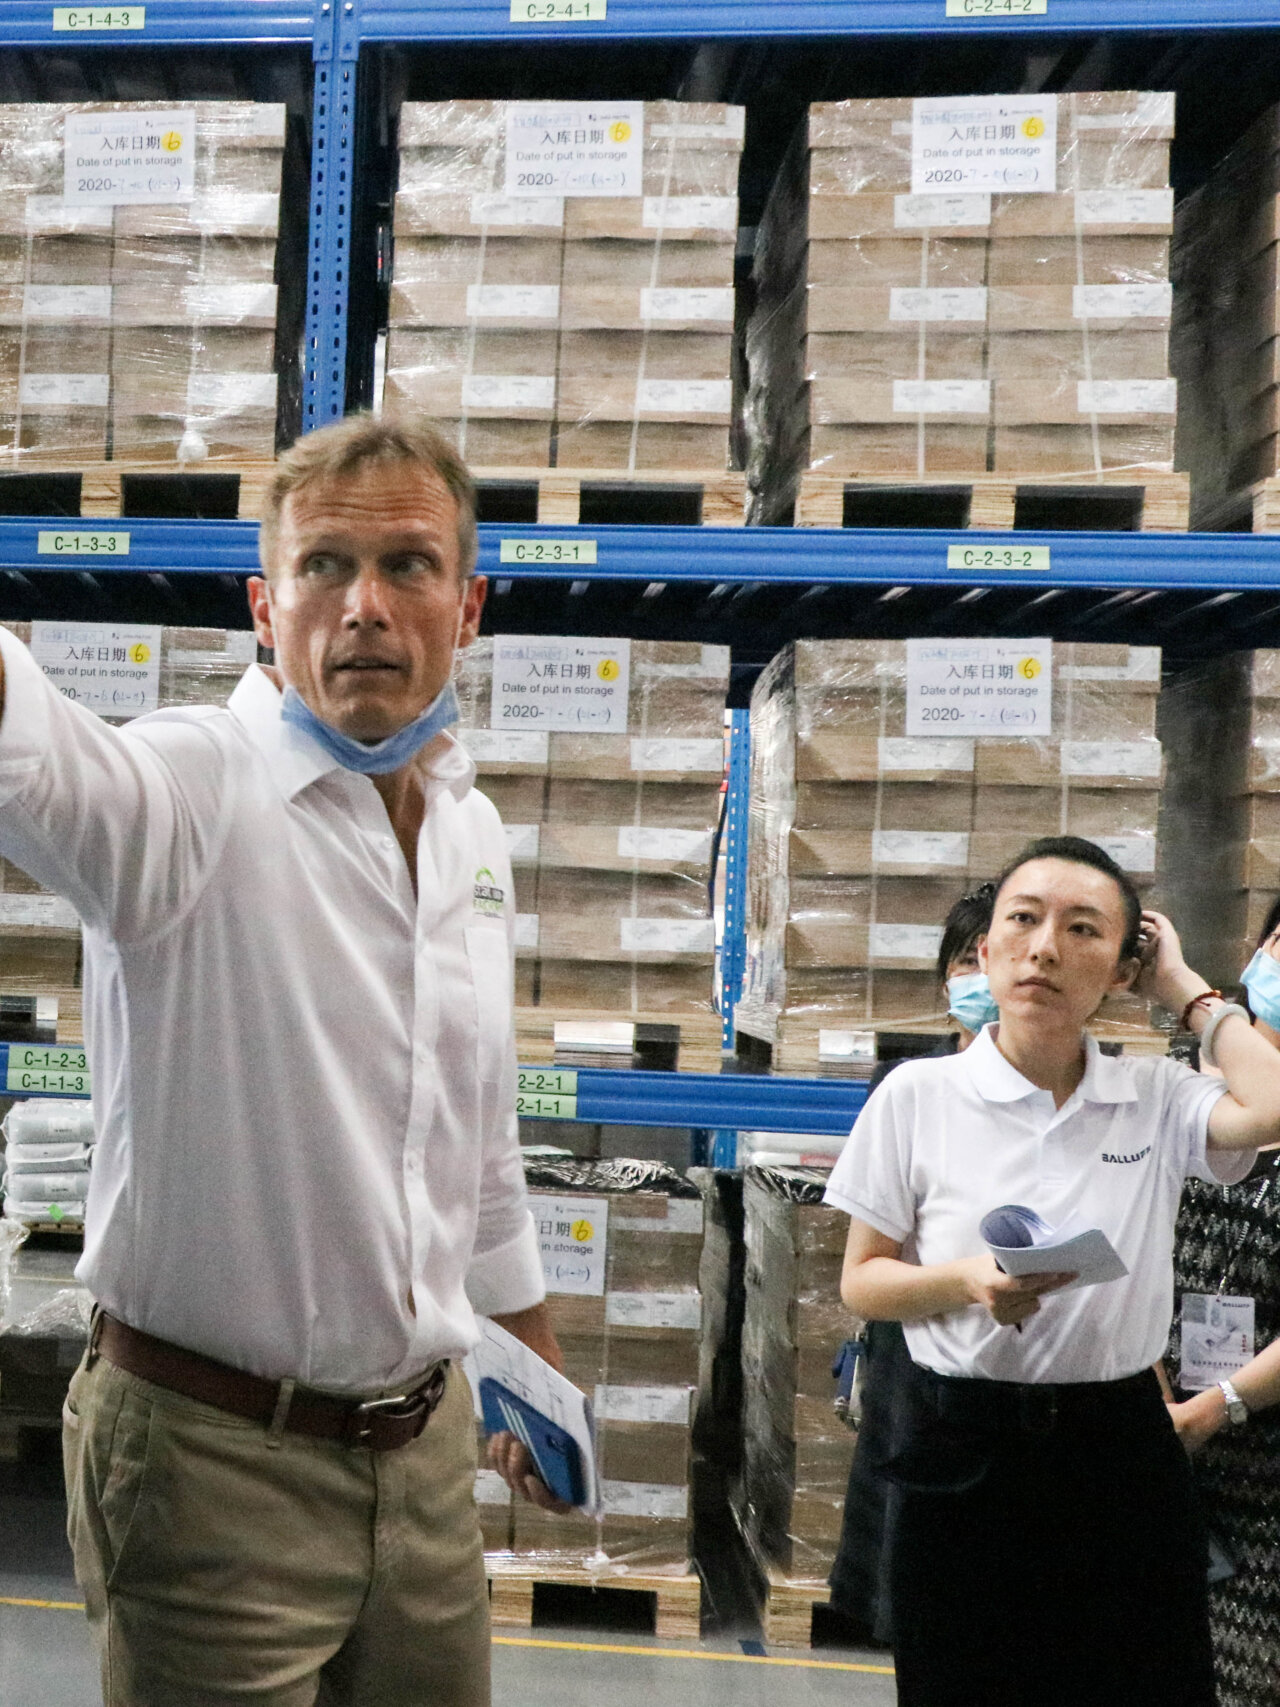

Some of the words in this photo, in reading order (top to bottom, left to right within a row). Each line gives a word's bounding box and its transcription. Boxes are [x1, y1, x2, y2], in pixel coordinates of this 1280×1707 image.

[527, 3, 590, 18] C-2-4-1
[964, 0, 1032, 13] C-2-4-2
[68, 12, 130, 27] C-1-4-3
[540, 130, 604, 145] 入库日期
[948, 125, 1016, 141] 入库日期
[100, 136, 160, 151] 入库日期
[516, 152, 540, 161] Date
[544, 151, 554, 161] of
[557, 152, 572, 162] put
[577, 151, 585, 160] in
[588, 151, 627, 161] storage
[923, 148, 949, 158] Date
[952, 148, 962, 158] of
[965, 148, 982, 158] put
[986, 147, 995, 156] in
[999, 146, 1040, 157] storage
[77, 157, 99, 167] Date
[103, 157, 112, 166] of
[115, 157, 131, 168] put
[134, 156, 142, 165] in
[145, 157, 182, 166] storage
[54, 536, 116, 551] C-1-3-3
[516, 545, 579, 560] C-2-3-1
[964, 551, 1032, 566] C-2-3-2
[65, 646, 126, 662] 入库日期
[42, 665, 65, 675] Date
[68, 665, 78, 675] of
[80, 666, 96, 678] put
[99, 665, 107, 676] in
[110, 668, 148, 679] storage
[526, 663, 591, 679] 入库日期
[946, 664, 1013, 679] 入库日期
[502, 683, 526, 693] Date
[530, 683, 540, 693] of
[543, 684, 559, 695] put
[562, 684, 571, 694] in
[574, 686, 614, 697] storage
[921, 685, 946, 695] Date
[949, 685, 960, 695] of
[963, 686, 980, 696] put
[984, 685, 993, 695] in
[997, 686, 1038, 697] storage
[24, 1051, 86, 1068] C-1-2-3
[22, 1073, 83, 1091] C-1-1-3
[1102, 1145, 1152, 1164] BALLUFF
[535, 1220, 570, 1237] 日期
[542, 1242, 550, 1251] in
[554, 1243, 593, 1255] storage
